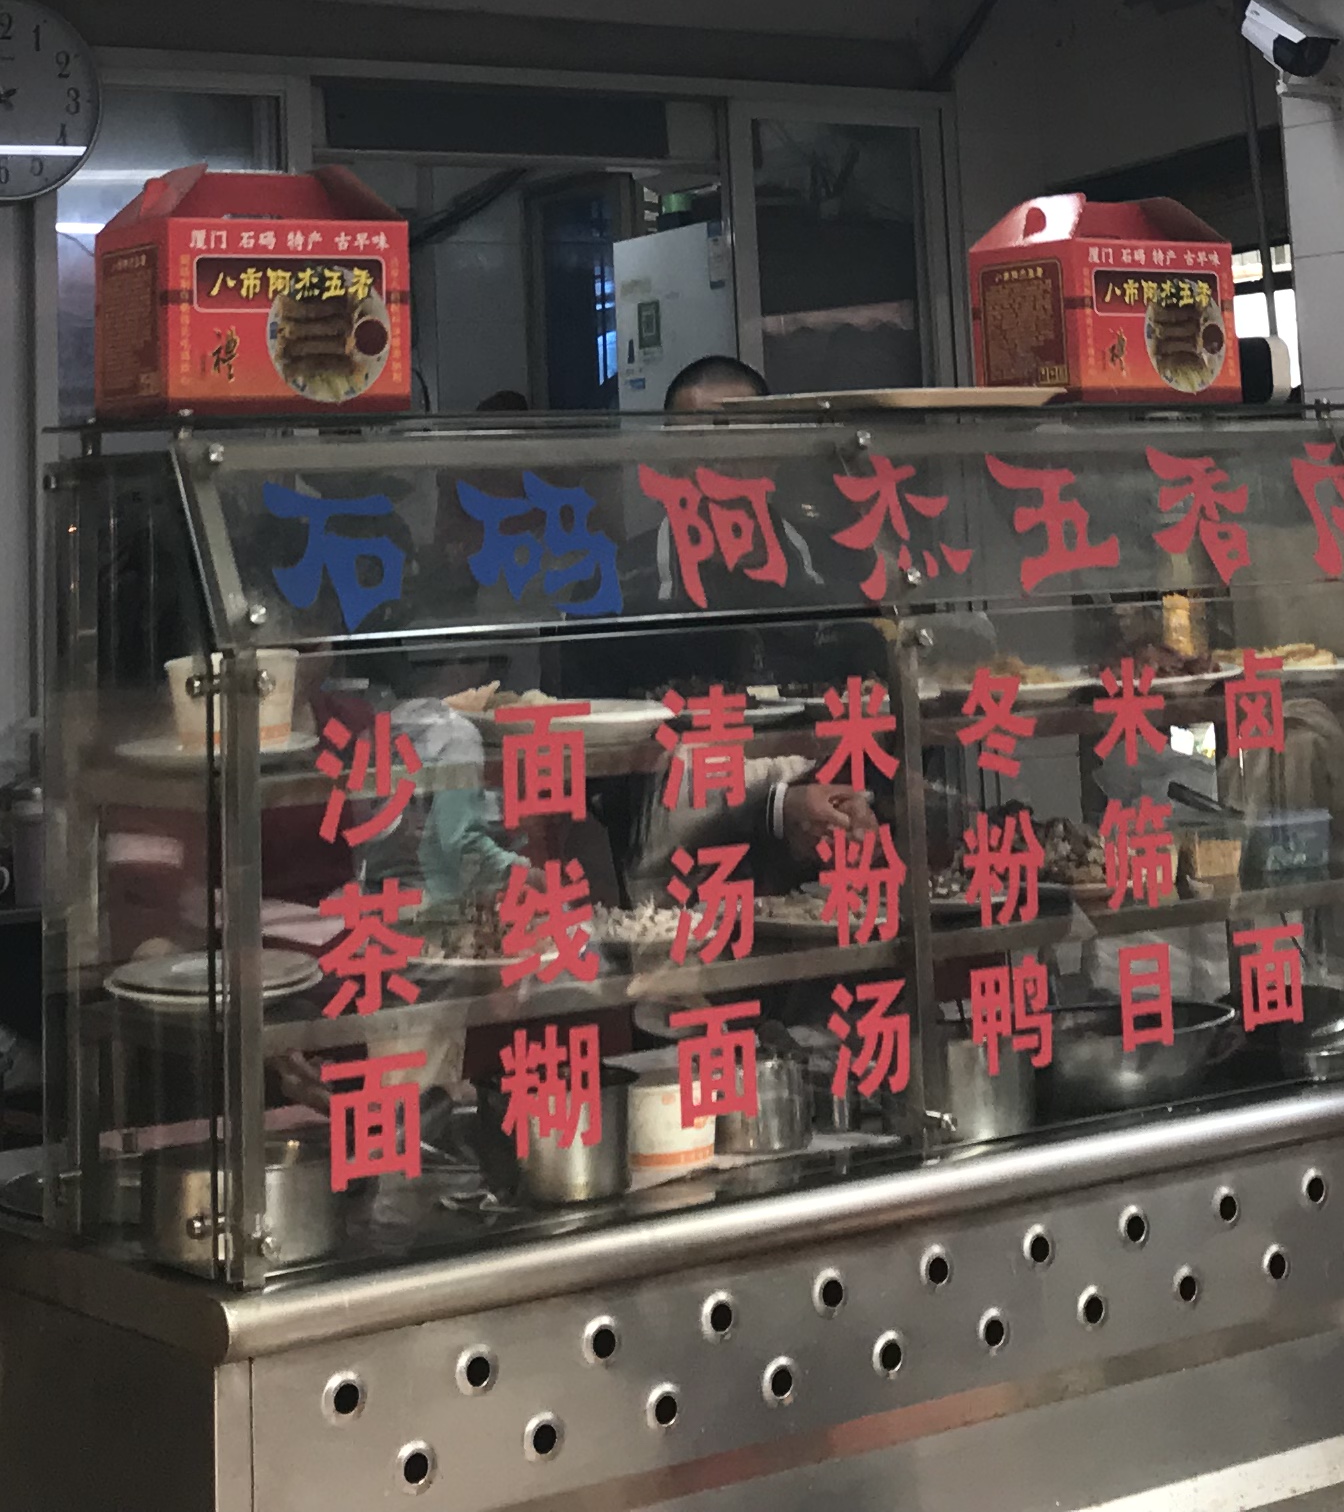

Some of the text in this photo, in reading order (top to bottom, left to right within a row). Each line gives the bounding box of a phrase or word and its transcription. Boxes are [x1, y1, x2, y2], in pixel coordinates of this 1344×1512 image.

[32, 24, 41, 52] 1
[56, 50, 71, 79] 2
[65, 86, 81, 116] 3
[189, 229, 227, 251] 厦门
[334, 231, 390, 252] 古早味
[209, 266, 374, 301] 八市阿杰五香
[315, 711, 428, 1192] 沙茶面
[495, 701, 603, 1159] 面线糊
[654, 684, 761, 1129] 清汤面
[814, 675, 911, 1099] 米粉汤
[957, 667, 1053, 1076] 冬粉鸭
[1092, 657, 1175, 1053] 米筛目
[1223, 649, 1305, 1032] 卤面
